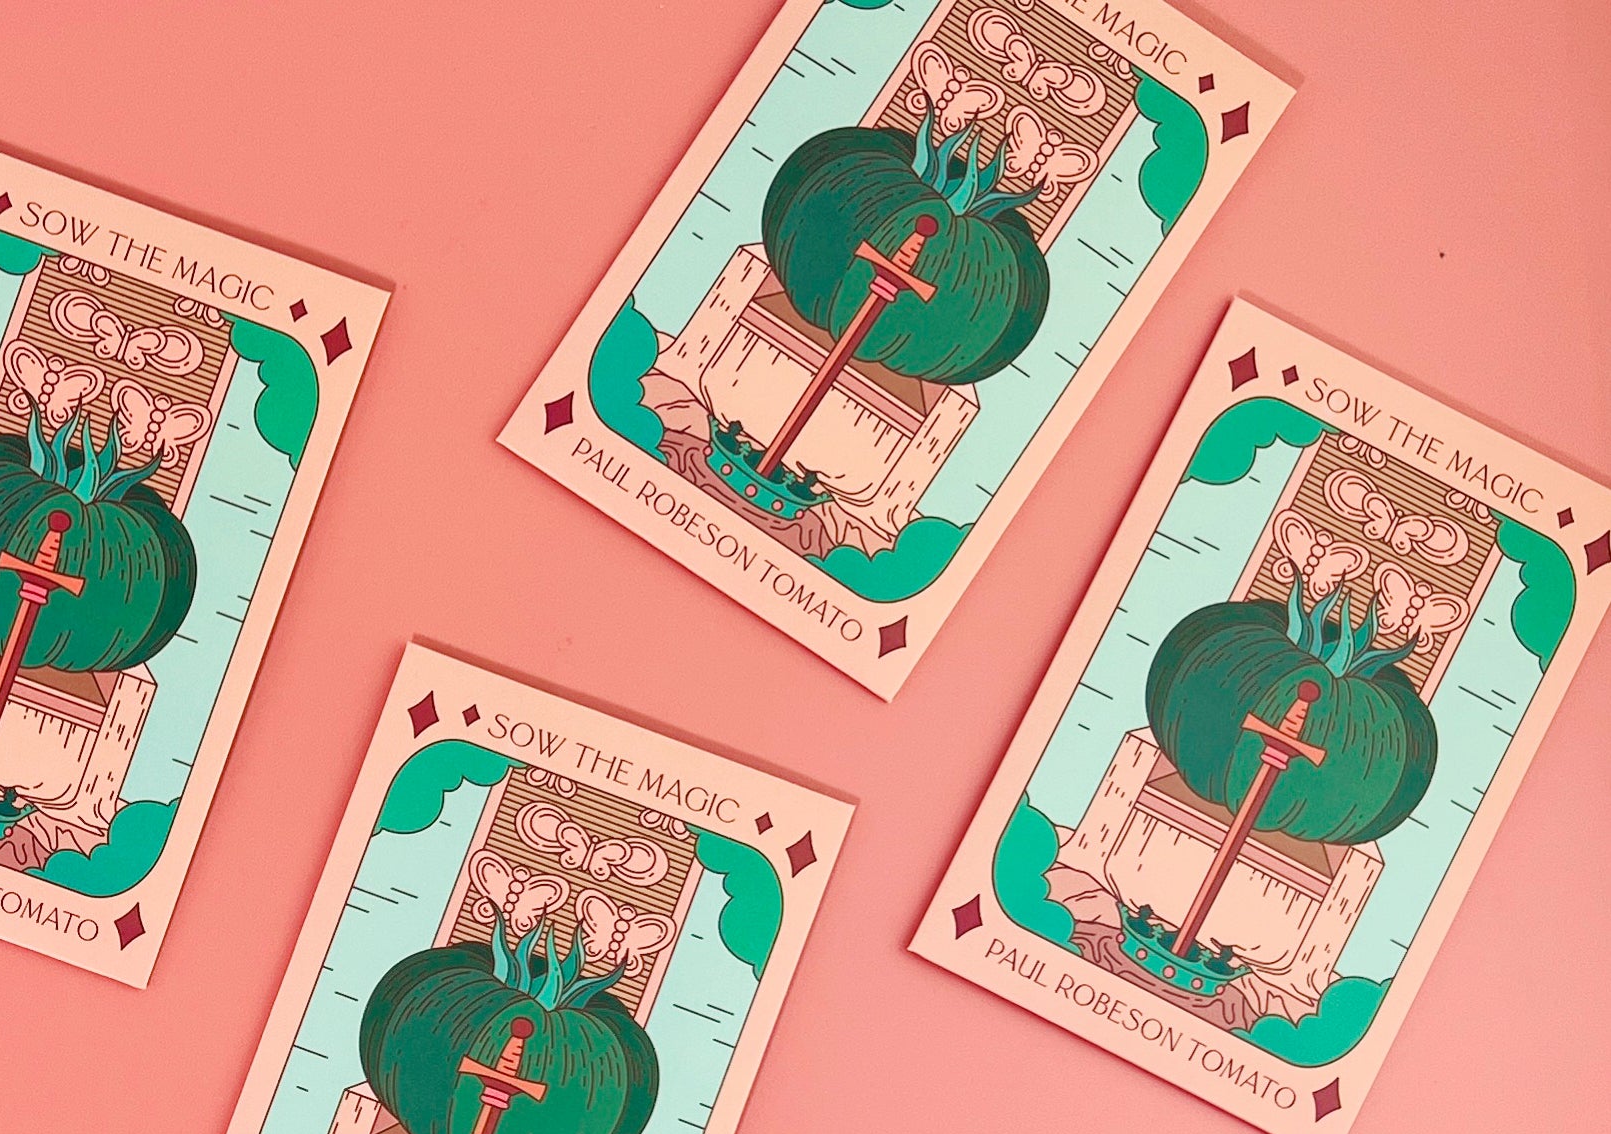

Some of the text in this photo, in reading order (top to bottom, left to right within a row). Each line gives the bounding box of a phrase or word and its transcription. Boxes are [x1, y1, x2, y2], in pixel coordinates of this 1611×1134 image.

[1092, 2, 1188, 75] MAGIC
[19, 201, 275, 311] SOW THE MAGIC
[1305, 377, 1544, 514] SOW THE MAGIC
[571, 437, 863, 642] PAUL ROBESON TOMATO
[487, 713, 740, 824] SOW THE MAGIC
[984, 938, 1297, 1110] PAUL ROBESON TOMATO
